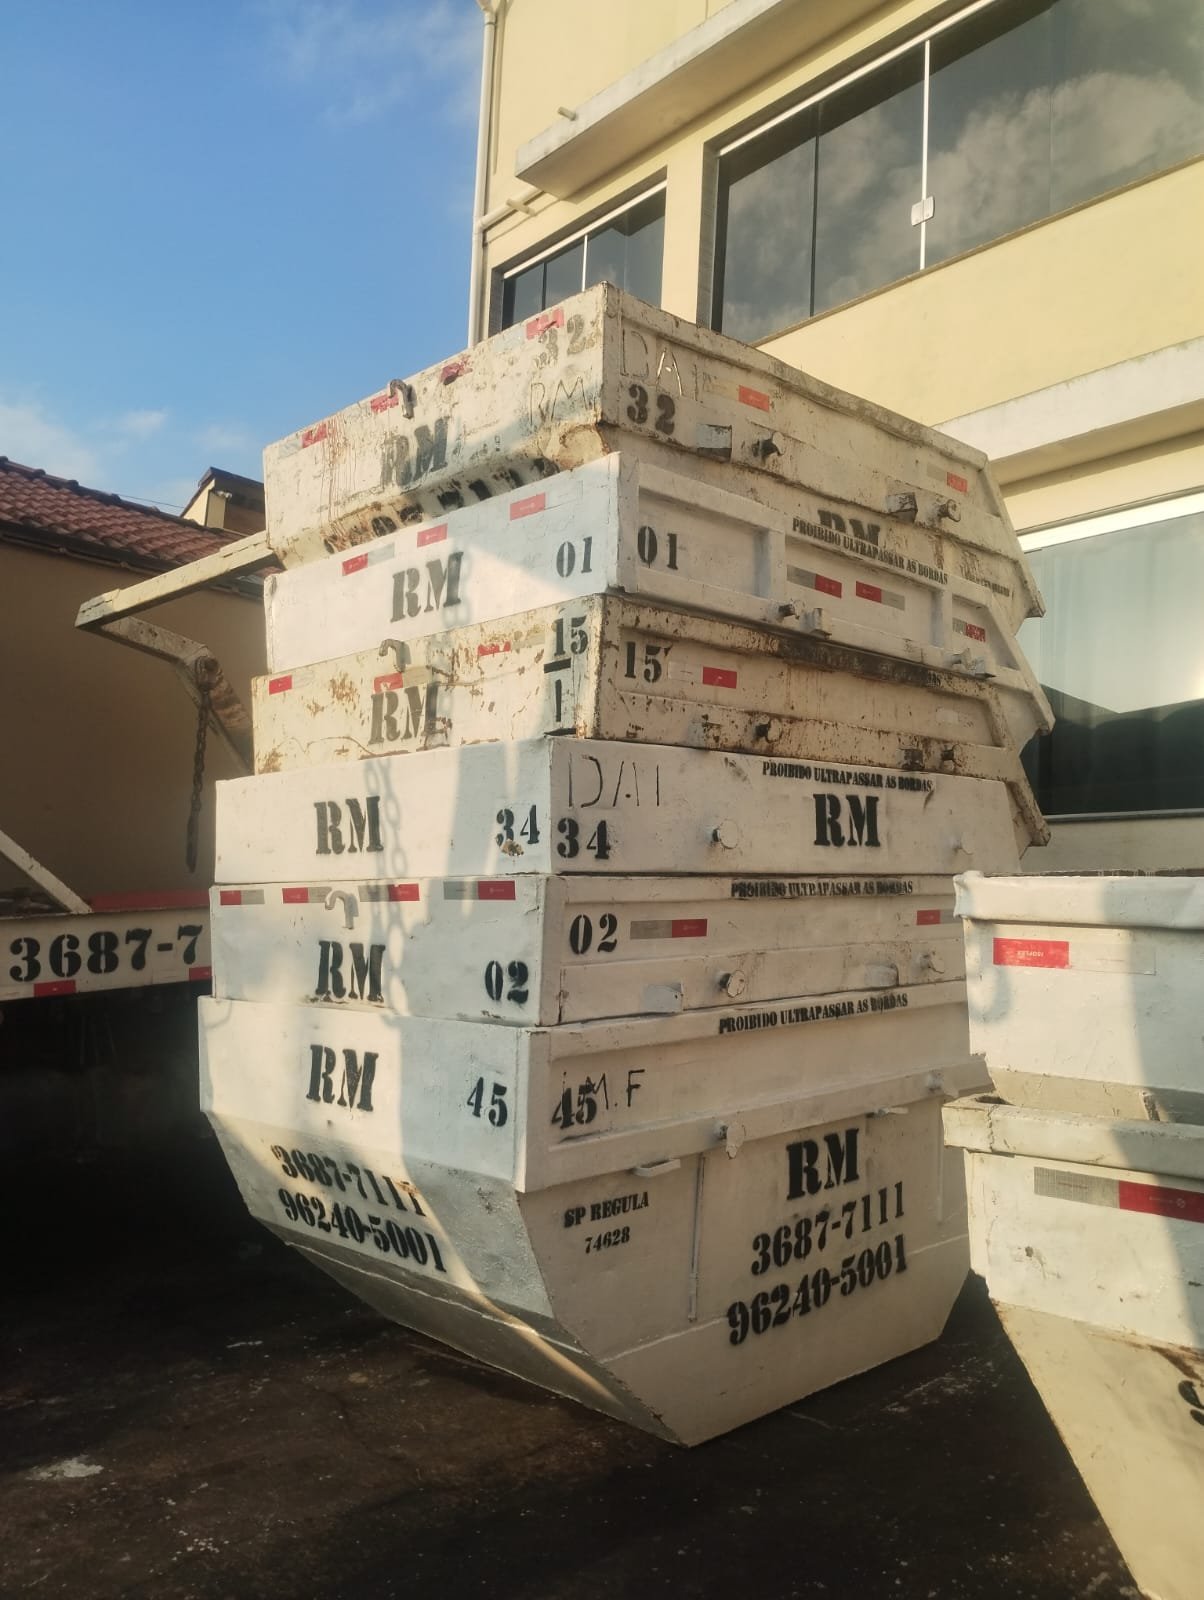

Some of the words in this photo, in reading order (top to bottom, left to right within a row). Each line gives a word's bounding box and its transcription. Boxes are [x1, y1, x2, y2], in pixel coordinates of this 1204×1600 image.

[626, 383, 676, 435] 32
[556, 536, 592, 578] 01
[636, 526, 679, 570] 01
[792, 517, 841, 547] PROIBIDO
[842, 535, 905, 570] ULTRAPASSAR
[905, 557, 918, 574] AS
[917, 562, 949, 585] BORDAS
[390, 551, 463, 623] RM
[552, 616, 588, 657] 15
[624, 641, 671, 684] 15
[368, 681, 440, 746] RM
[762, 761, 812, 780] PROIBIDO
[813, 767, 883, 788] ULTRAPASSAR
[885, 775, 897, 788] AS
[897, 776, 933, 793] BORDAS
[314, 796, 384, 855] RM
[496, 804, 540, 850] 34
[557, 817, 611, 860] 34
[812, 793, 881, 847] RM
[731, 881, 787, 897] PROIBIDO
[788, 882, 861, 897] ULTRAPASSAR
[862, 881, 875, 895] AS
[876, 881, 913, 895] BORDAS
[9, 924, 203, 983] 3687-7
[570, 912, 618, 955] 02
[315, 940, 386, 1001] RM
[485, 960, 529, 1003] 02
[719, 1013, 778, 1034] PROIBIDO
[780, 1002, 855, 1025] ULTRAPASSAR
[856, 999, 869, 1013] AS
[870, 994, 908, 1011] BORDAS
[306, 1044, 379, 1112] RM
[467, 1077, 508, 1127] 45
[551, 1087, 598, 1130] 45
[271, 1144, 427, 1217] 3687-7111
[786, 1128, 859, 1200] RM
[278, 1188, 447, 1273] 96240-5001
[563, 1206, 587, 1228] SP
[590, 1191, 649, 1222] REGULA
[751, 1181, 904, 1276] 3687-7111
[585, 1226, 630, 1254] 74628
[727, 1234, 907, 1346] 96240-5001
